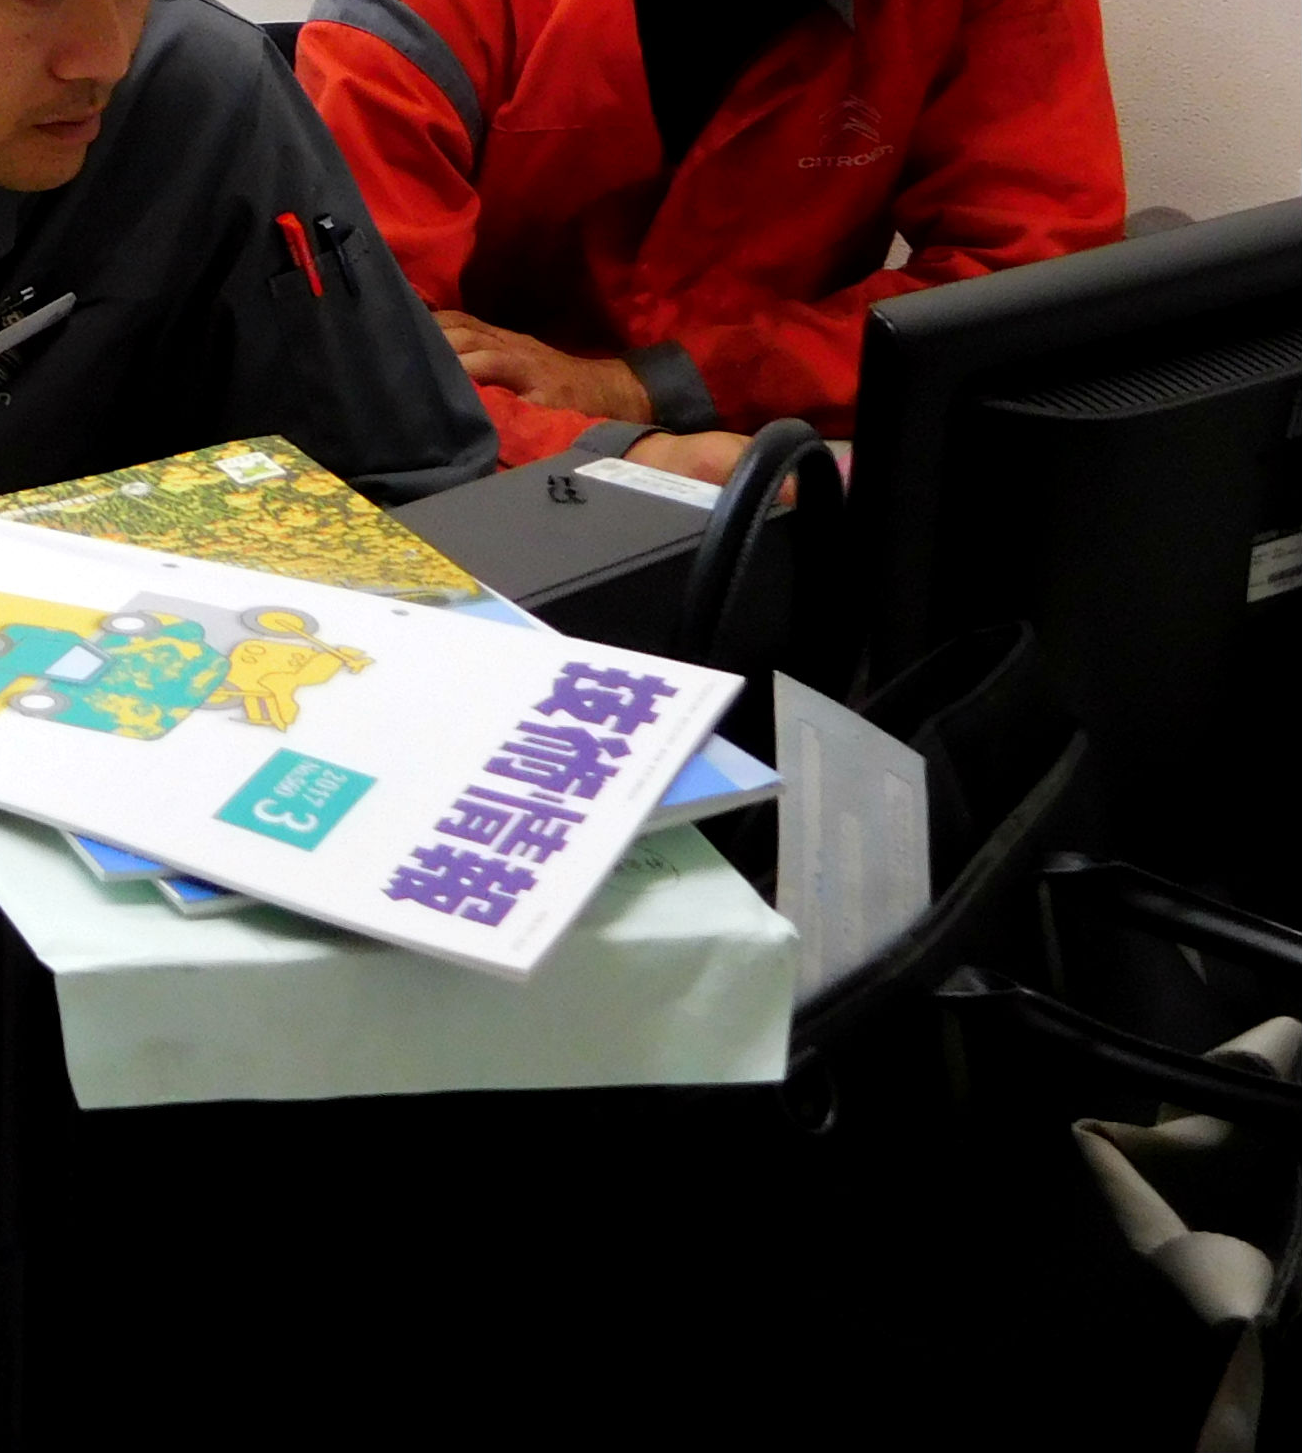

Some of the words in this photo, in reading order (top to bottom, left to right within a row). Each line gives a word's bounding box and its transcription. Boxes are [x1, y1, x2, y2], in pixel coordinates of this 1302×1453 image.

[303, 769, 348, 808] 2017
[379, 661, 681, 928] 技術情報
[253, 796, 319, 833] 3
